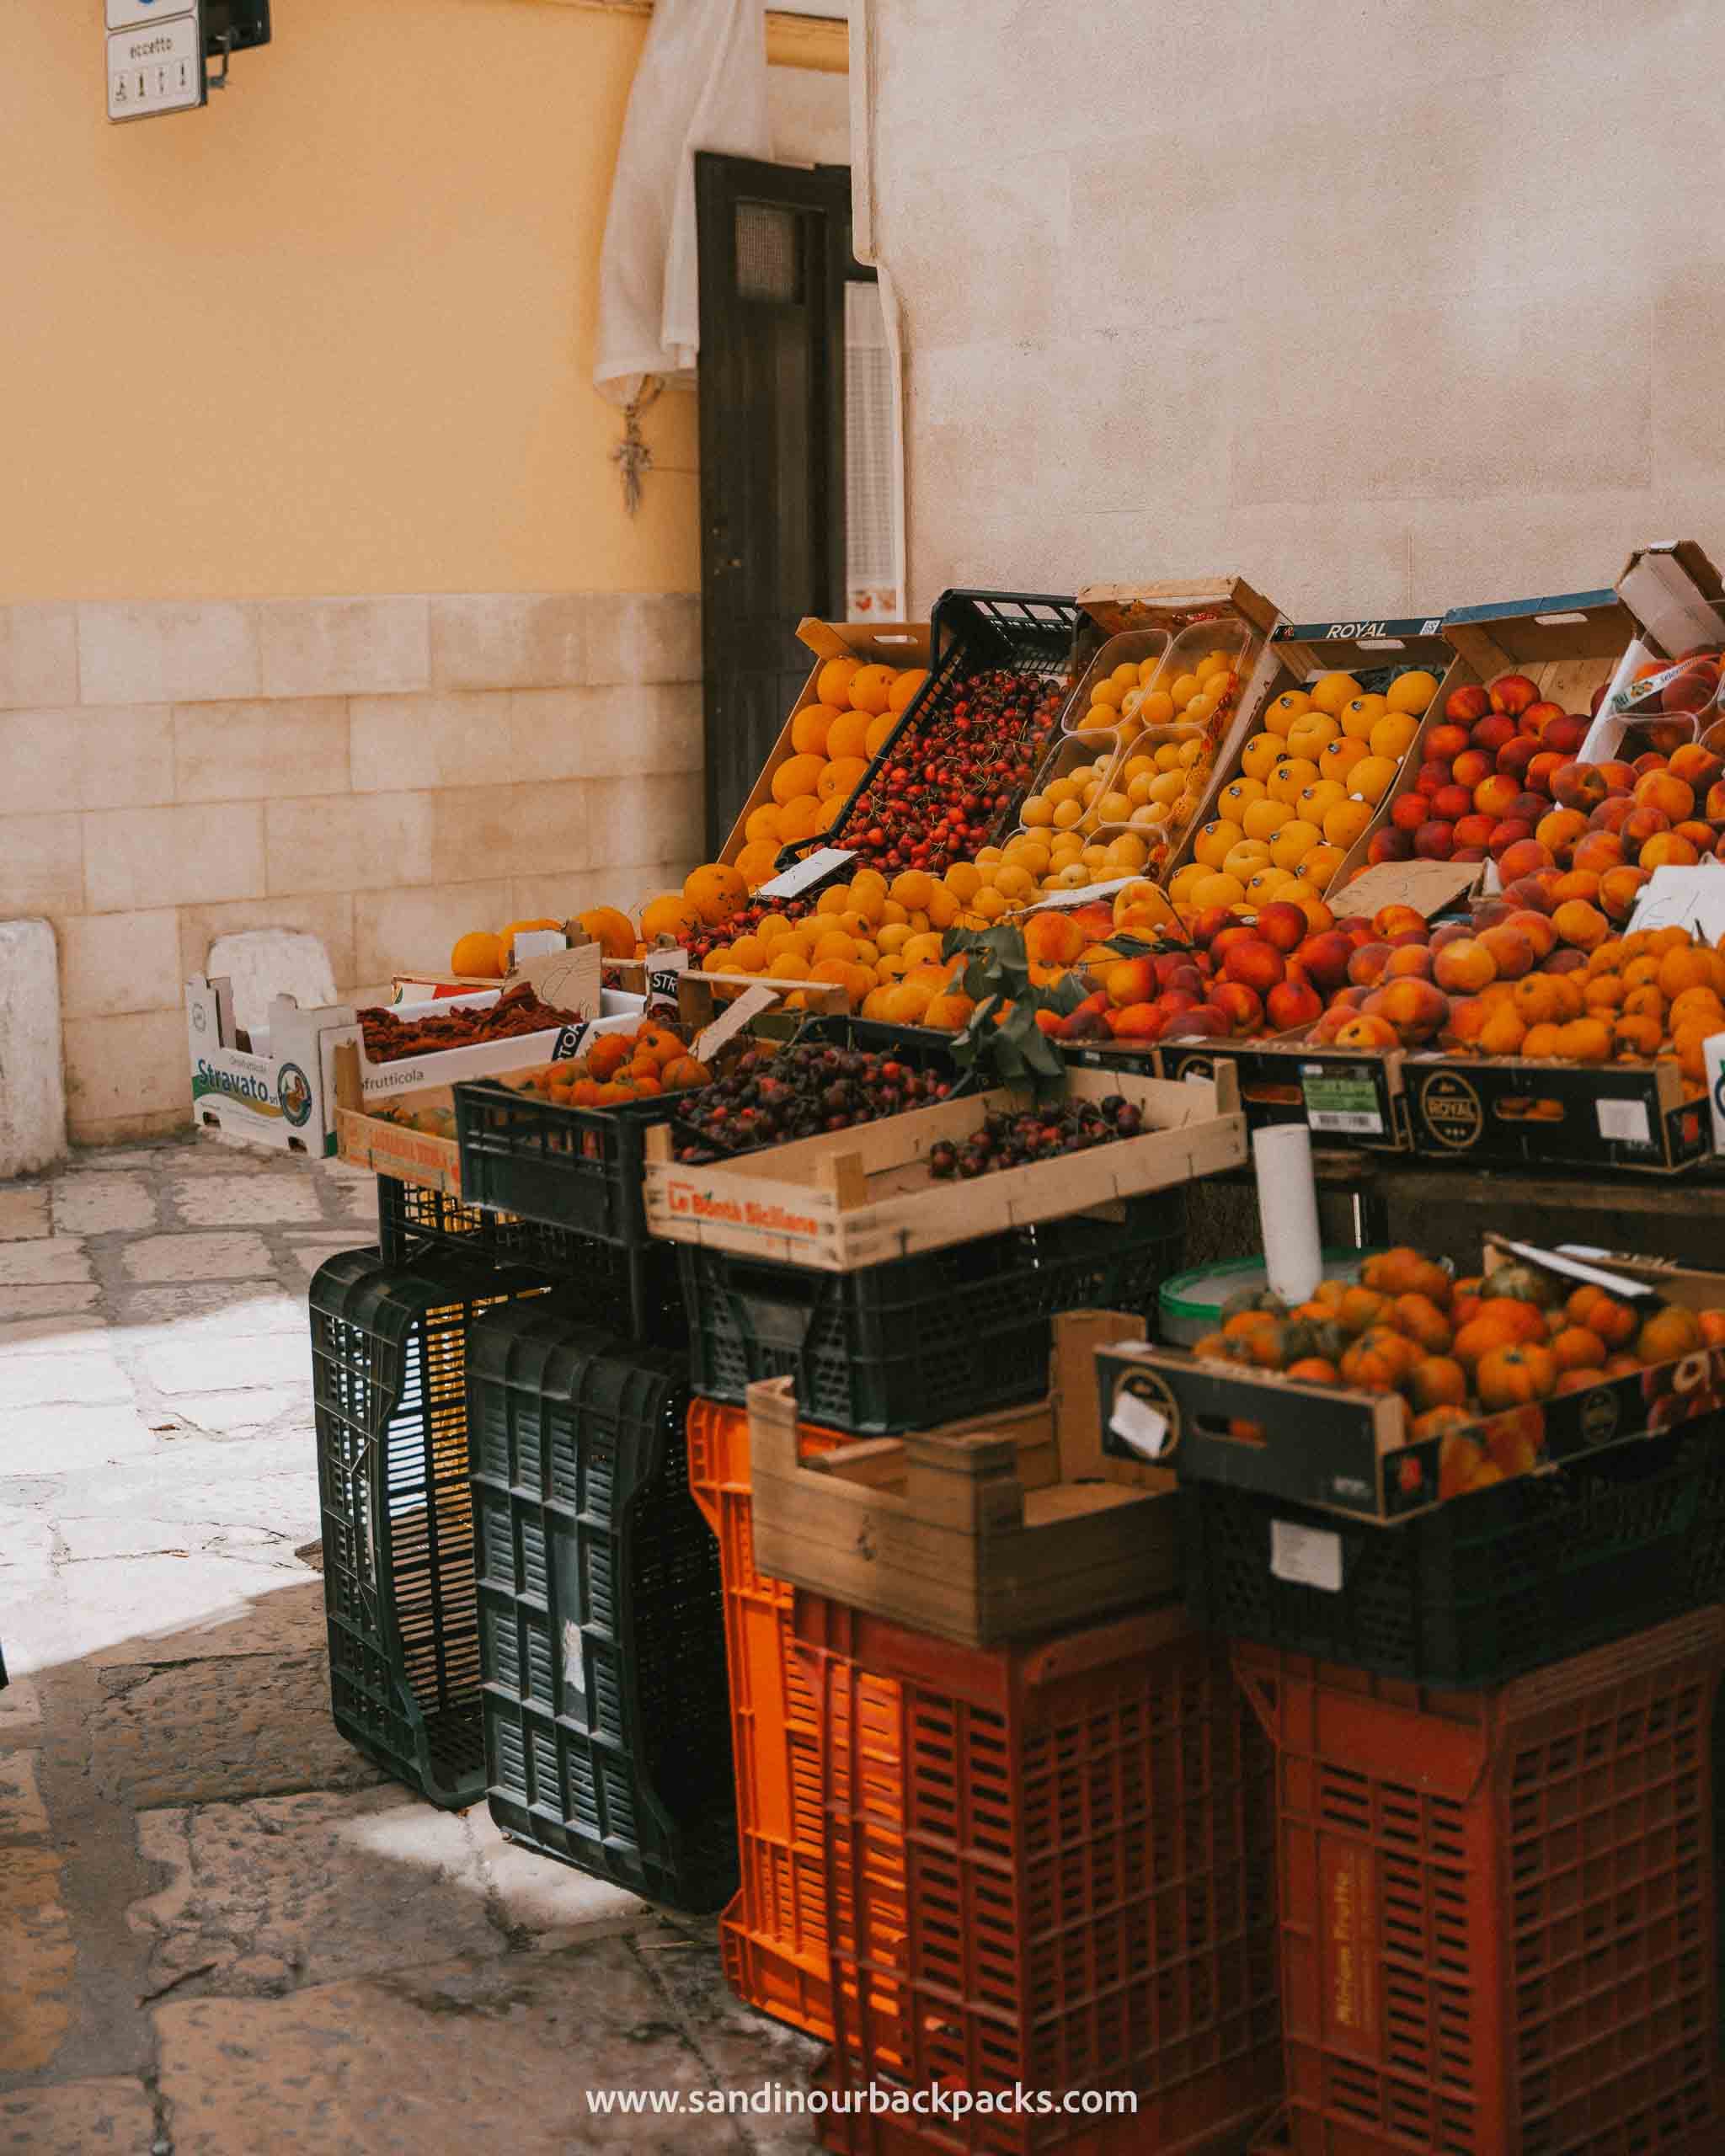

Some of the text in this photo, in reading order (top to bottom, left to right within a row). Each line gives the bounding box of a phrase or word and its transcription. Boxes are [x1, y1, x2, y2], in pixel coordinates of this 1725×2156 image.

[130, 37, 173, 59] eccetto
[1326, 622, 1387, 639] ROYAL
[197, 1058, 269, 1102] Stravato
[334, 1069, 425, 1094] frutticola
